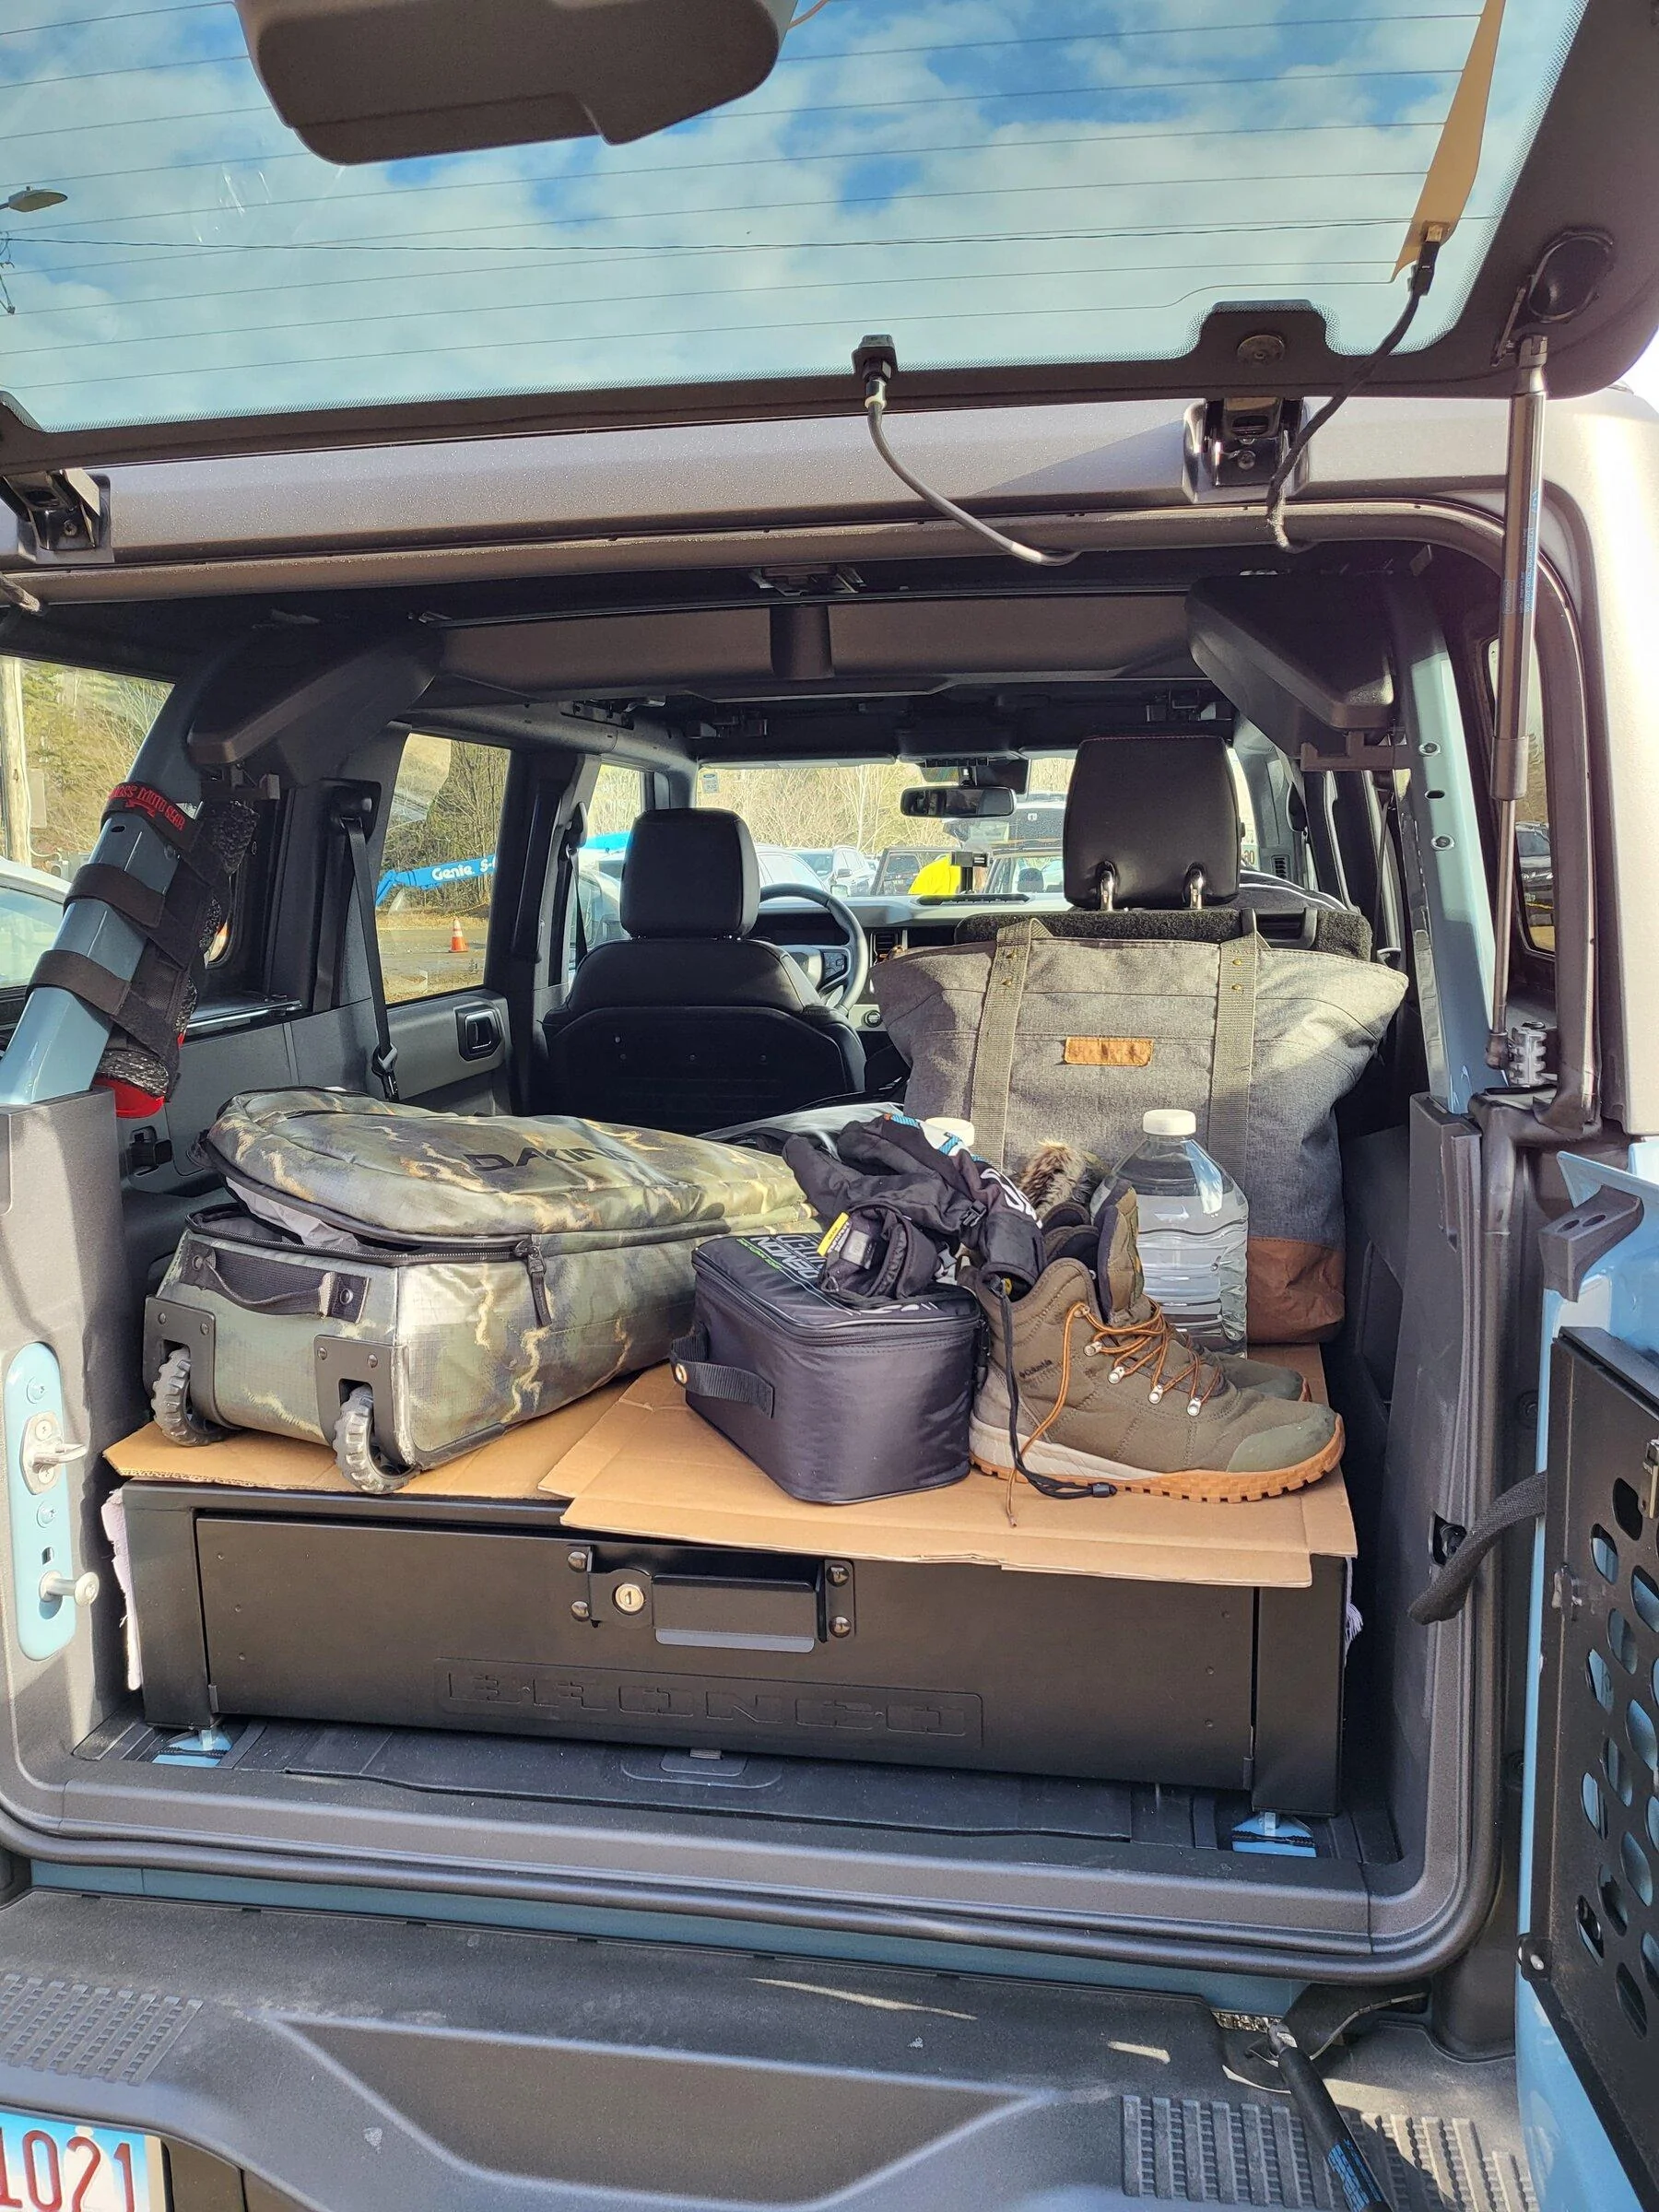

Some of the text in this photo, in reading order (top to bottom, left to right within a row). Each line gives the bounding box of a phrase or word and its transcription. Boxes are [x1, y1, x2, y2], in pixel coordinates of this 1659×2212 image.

[431, 865, 473, 881] Genie
[463, 1147, 636, 1171] DAKINE
[749, 1236, 820, 1279] DEMON
[448, 1670, 967, 1738] BRONCO
